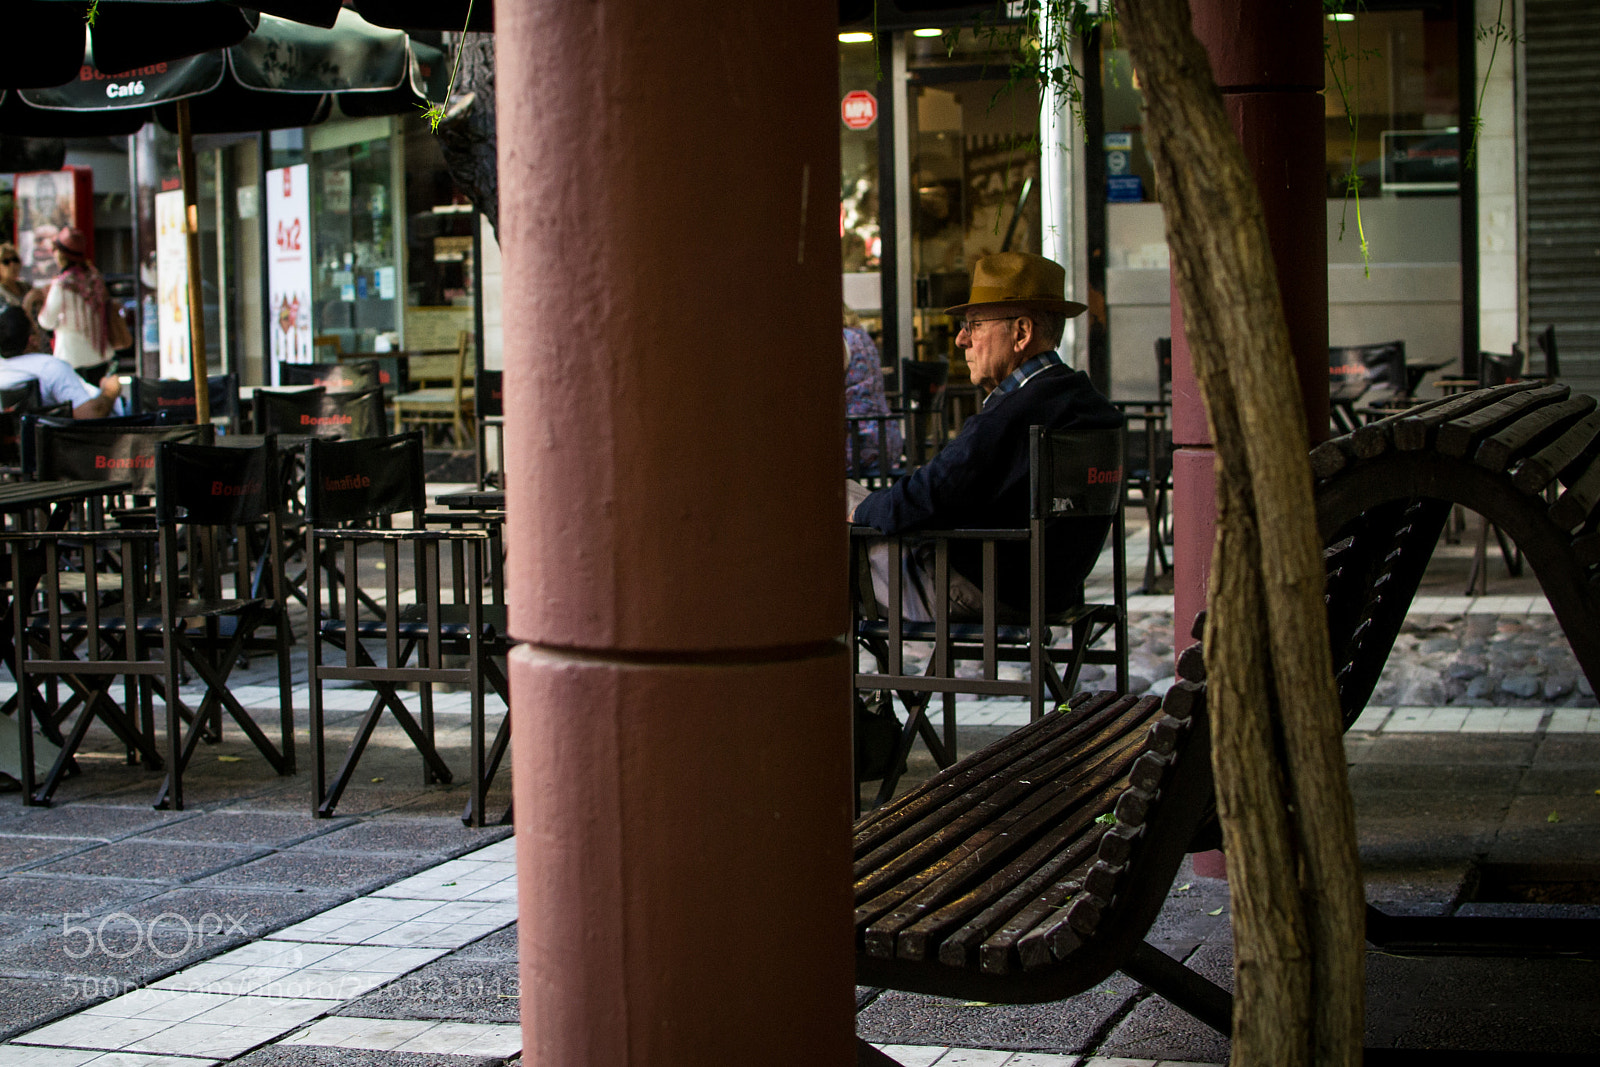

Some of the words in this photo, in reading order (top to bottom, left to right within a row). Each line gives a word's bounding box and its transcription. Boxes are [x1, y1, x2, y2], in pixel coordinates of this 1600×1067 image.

[106, 81, 145, 98] Café
[300, 414, 352, 426] Bonafide
[95, 455, 155, 469] Bonafid
